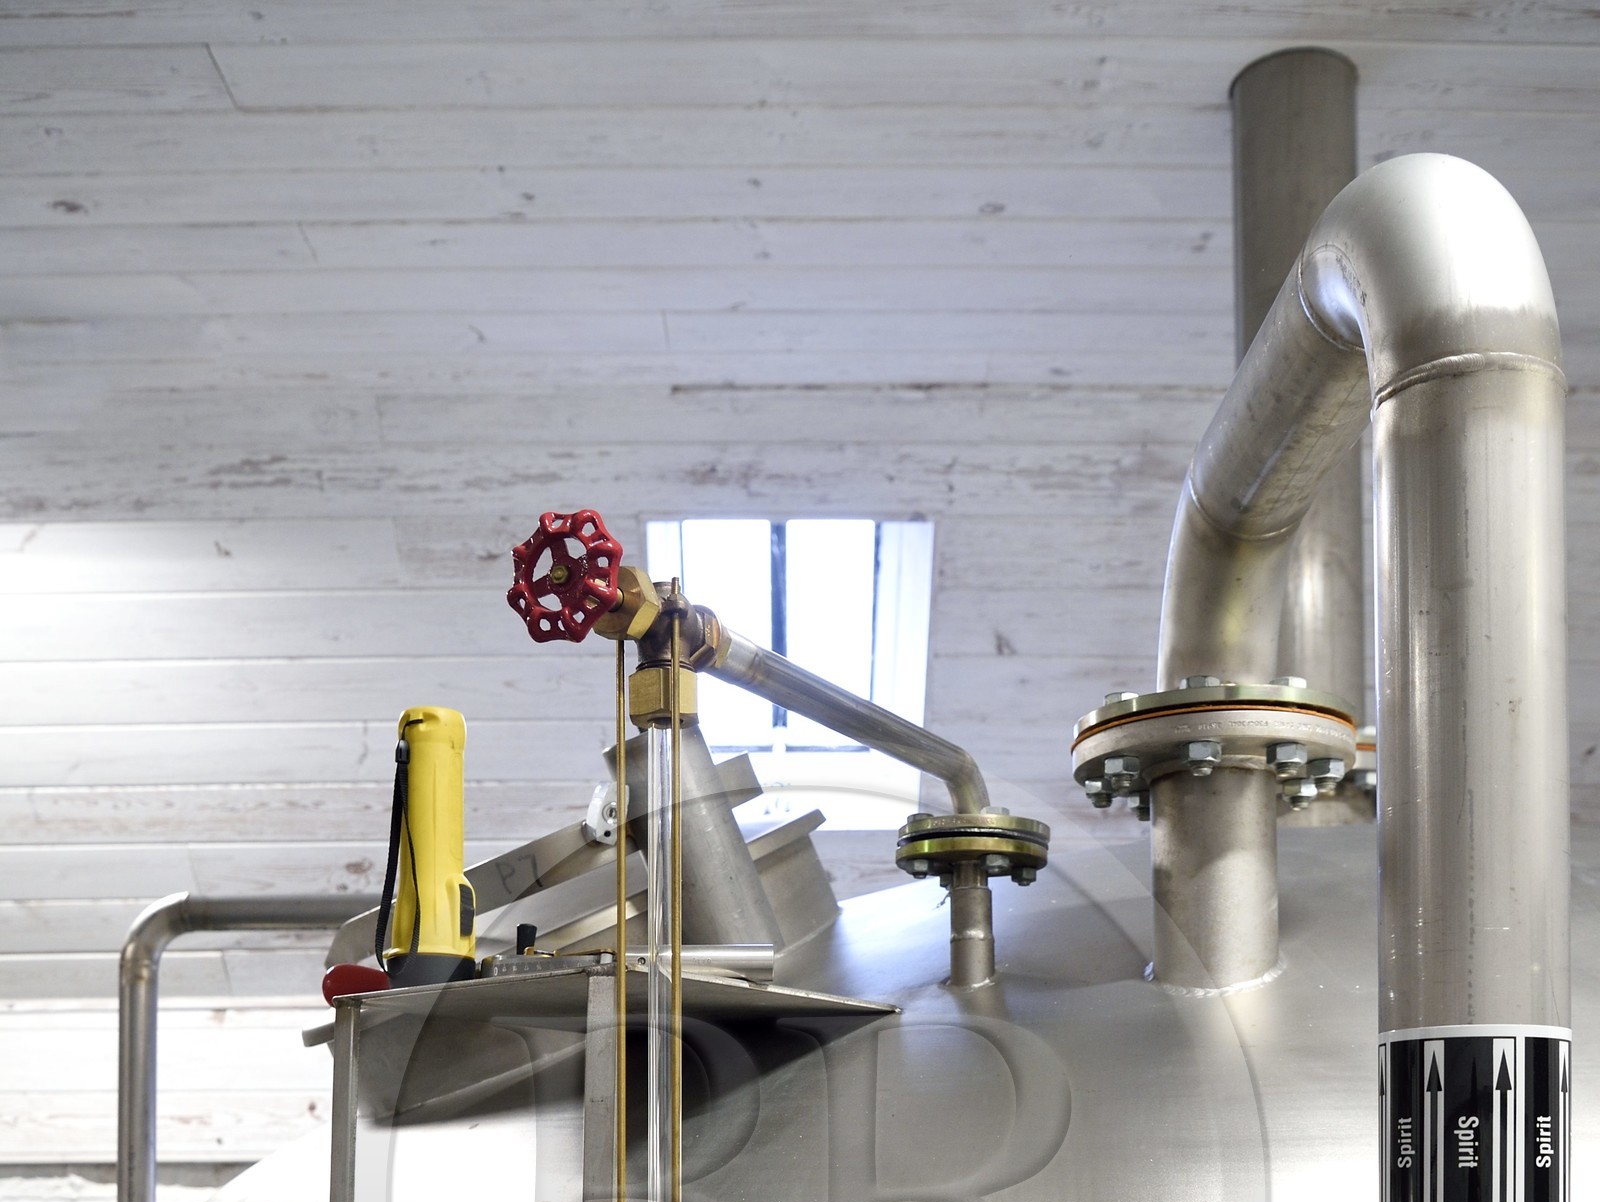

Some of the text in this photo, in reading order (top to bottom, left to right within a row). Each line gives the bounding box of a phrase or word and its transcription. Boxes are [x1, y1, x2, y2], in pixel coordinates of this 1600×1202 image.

[1397, 1116, 1416, 1169] Spirit
[1453, 1115, 1480, 1169] Spirit
[1536, 1115, 1555, 1169] Spirit
